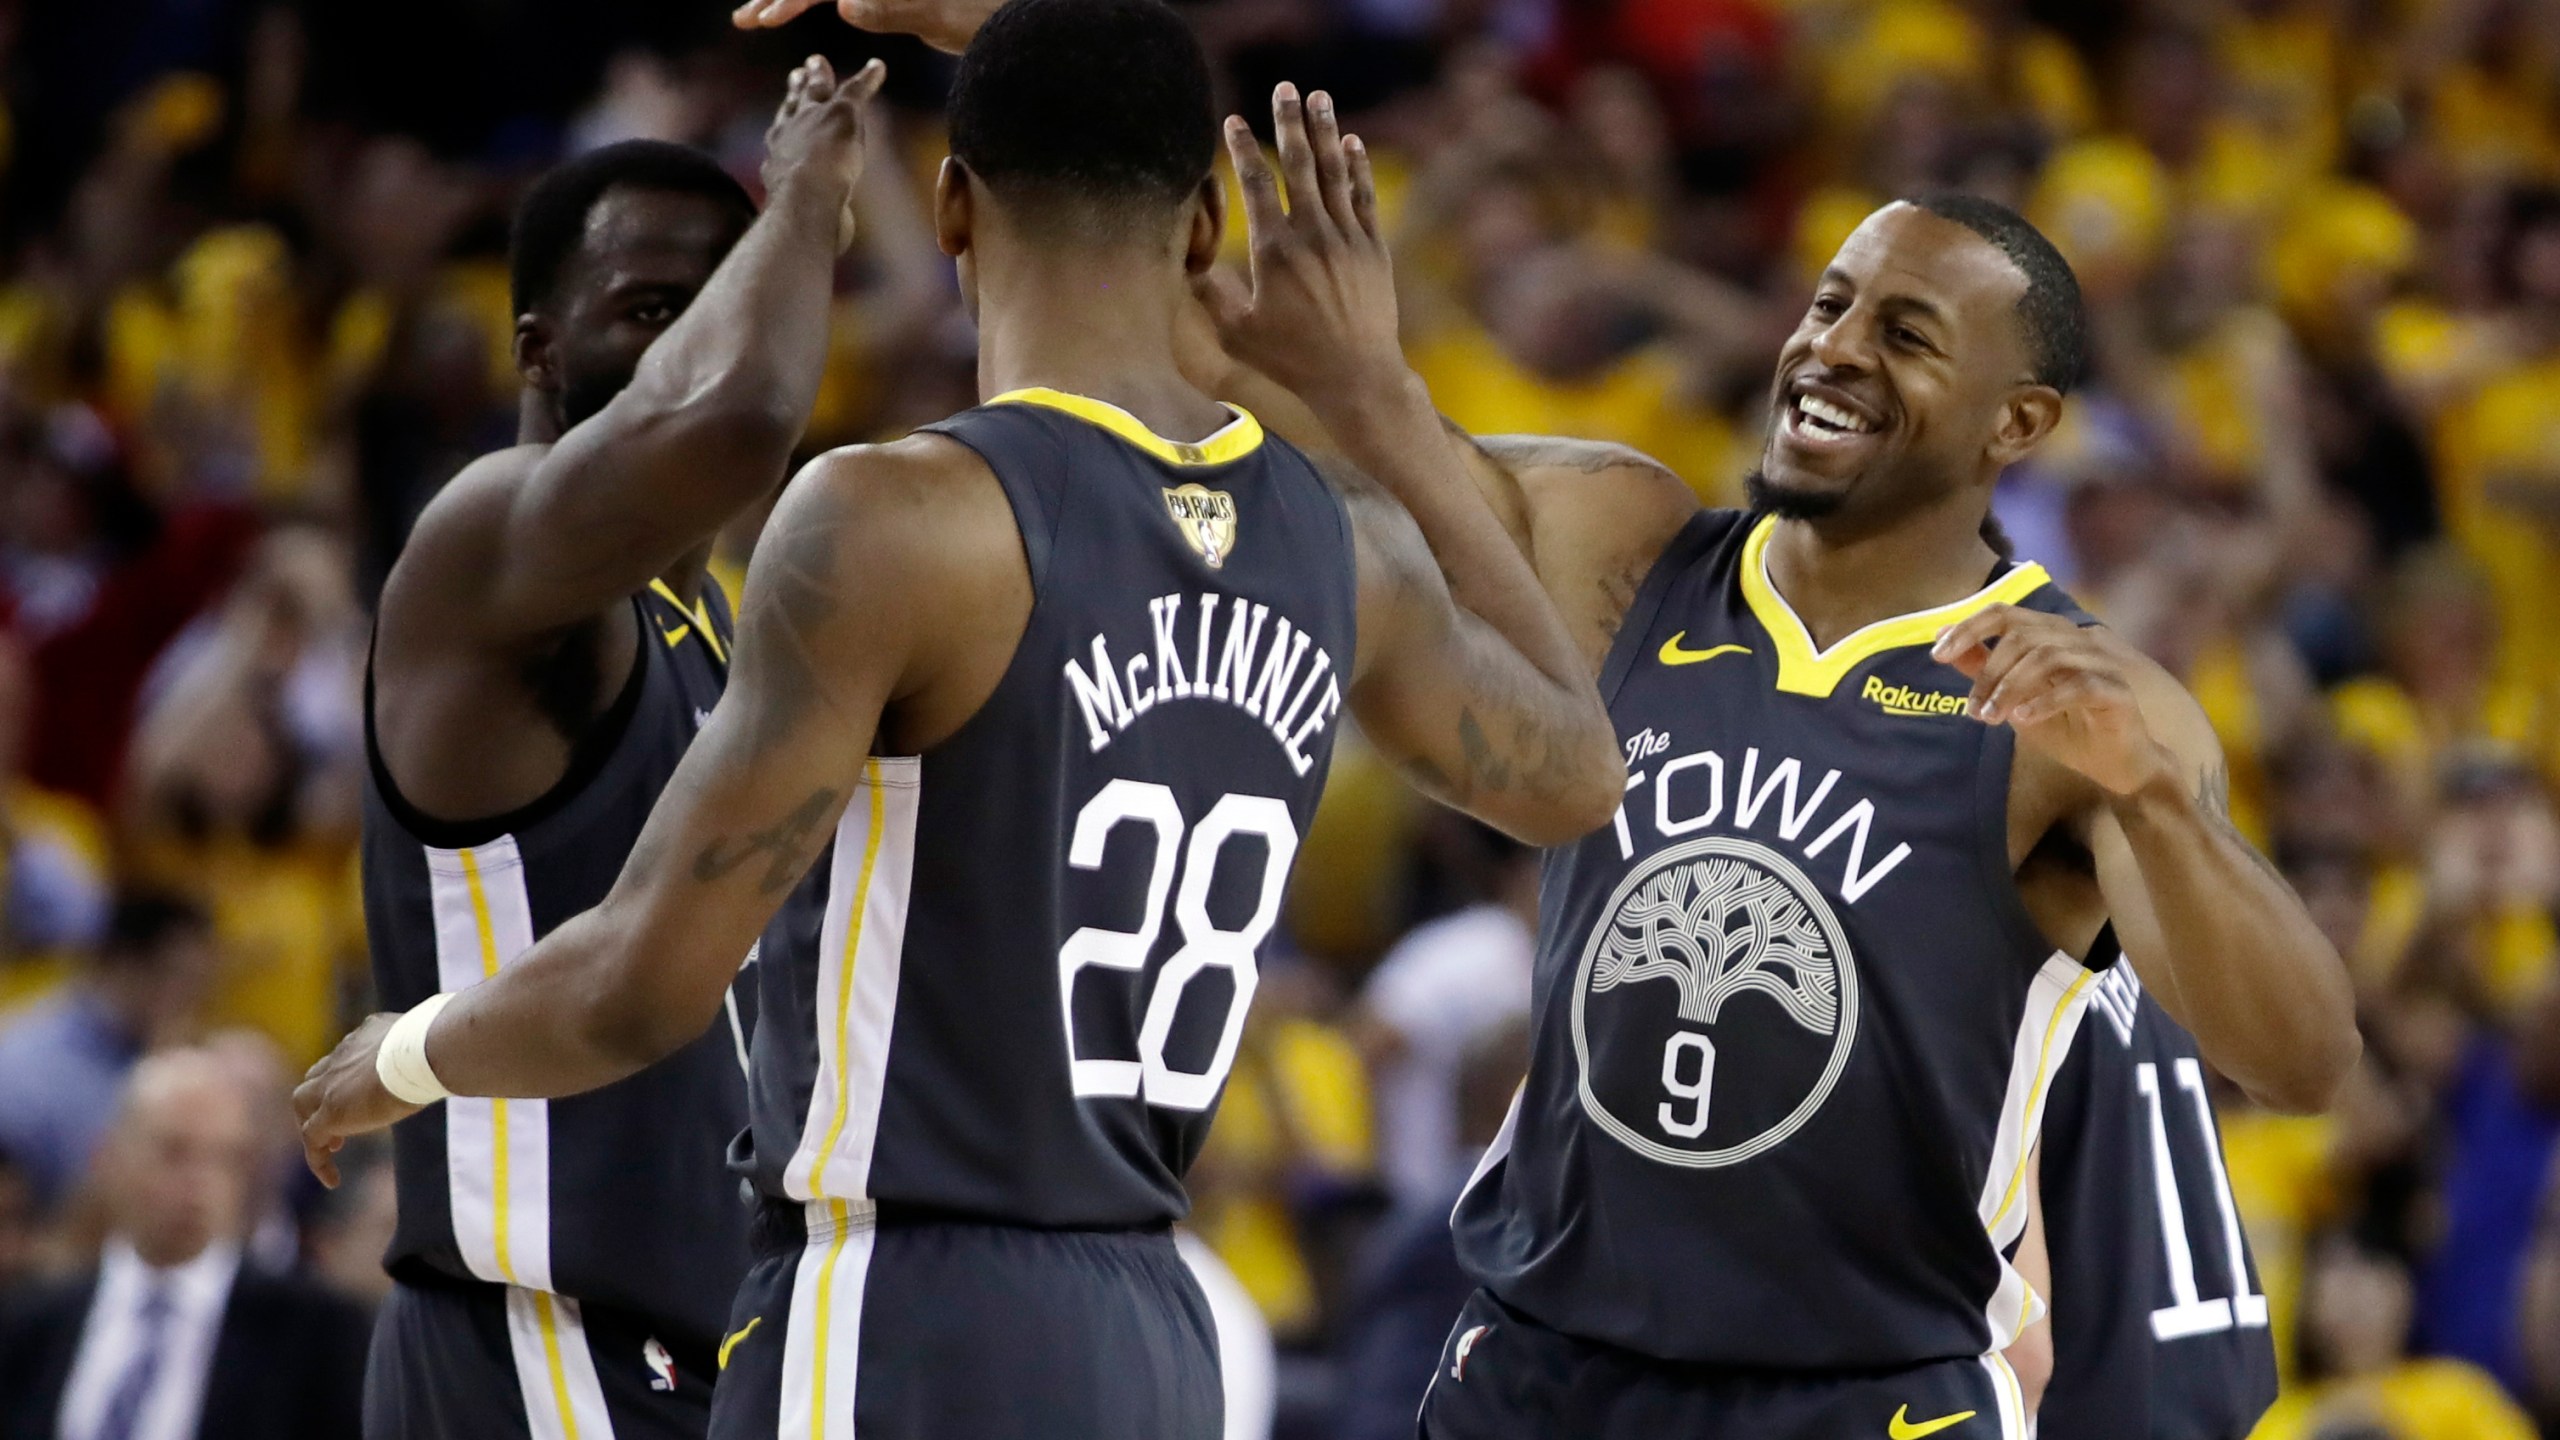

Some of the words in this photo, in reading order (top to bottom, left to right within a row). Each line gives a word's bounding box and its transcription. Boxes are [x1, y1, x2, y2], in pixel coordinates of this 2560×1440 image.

[1191, 495, 1232, 521] FINALS
[1064, 593, 1341, 776] McKINNIE
[1625, 726, 1671, 766] The
[1861, 674, 1970, 717] Rakuten
[1613, 747, 1912, 904] TOWN
[1059, 779, 1298, 1109] 28
[1657, 1031, 1716, 1138] 9
[2136, 1057, 2268, 1342] 11
